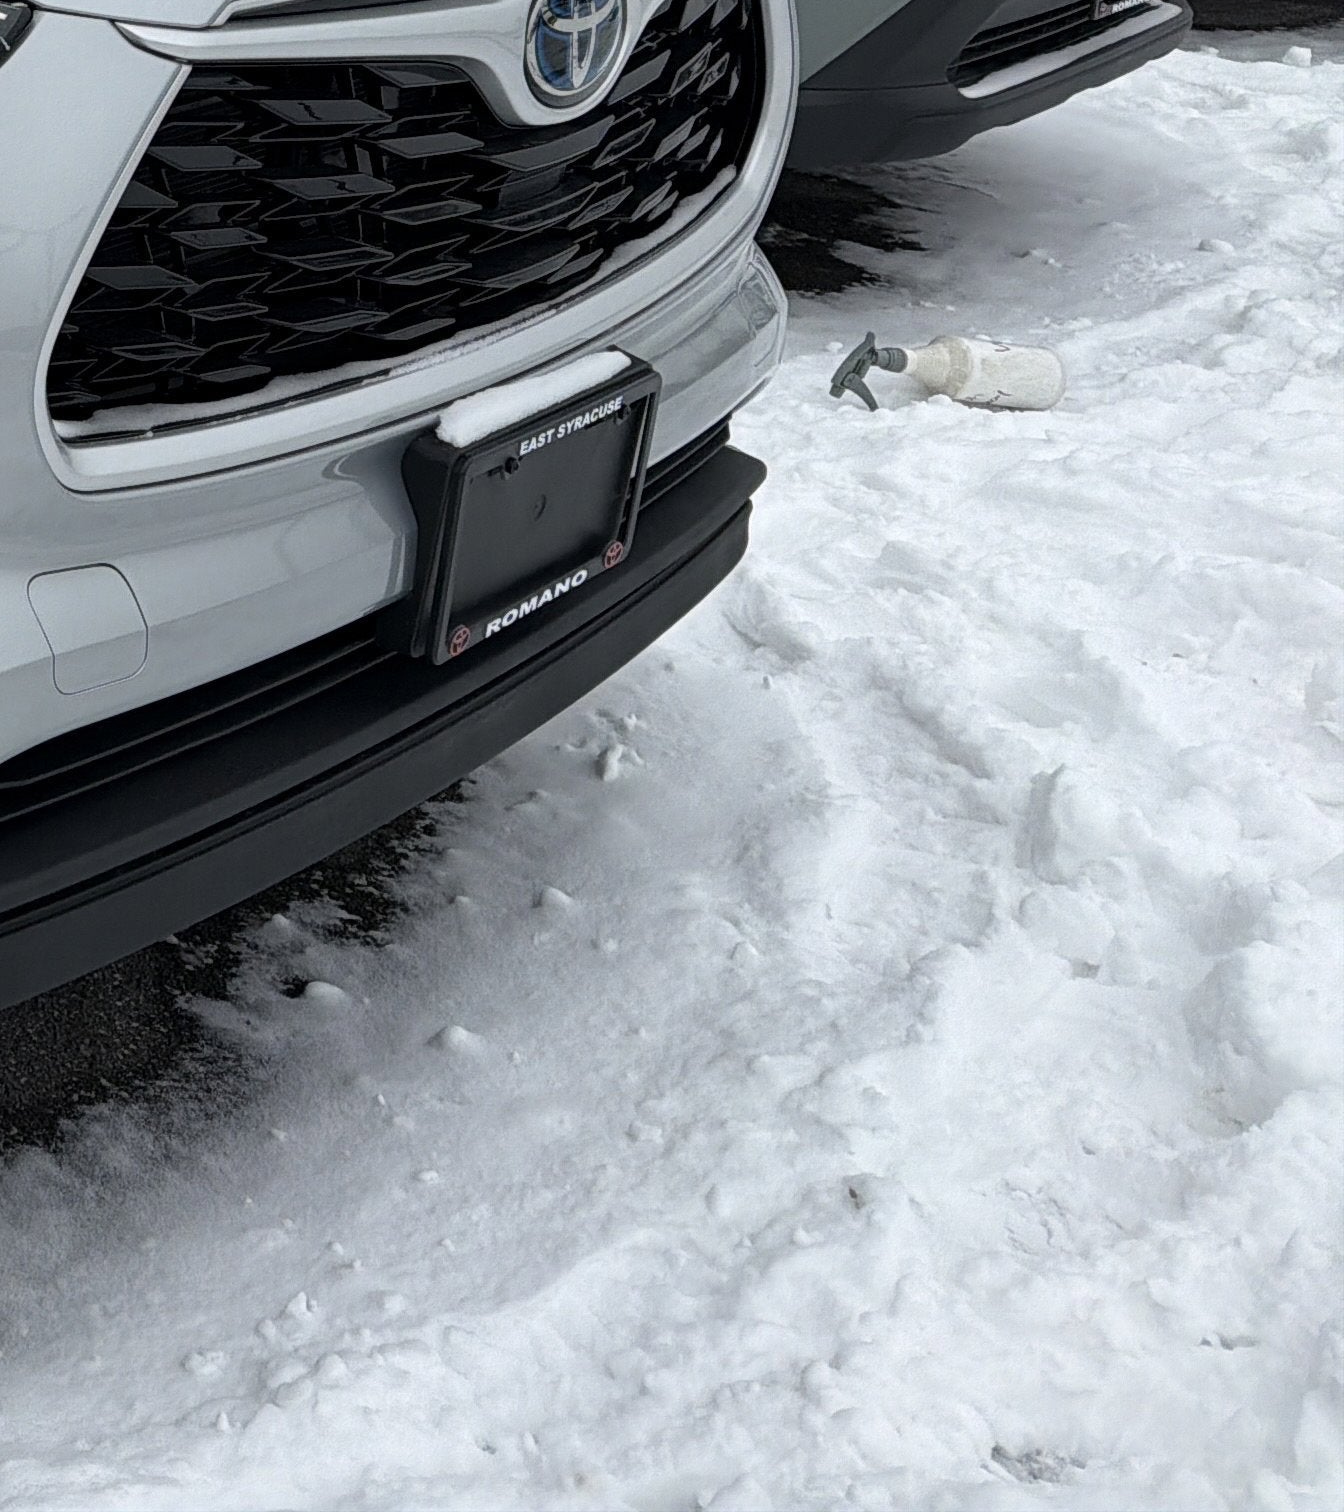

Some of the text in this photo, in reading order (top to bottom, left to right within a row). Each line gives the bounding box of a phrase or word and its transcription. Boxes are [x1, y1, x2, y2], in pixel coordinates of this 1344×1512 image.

[519, 396, 624, 456] EAST SYRACUSE
[485, 569, 589, 638] ROMANO
